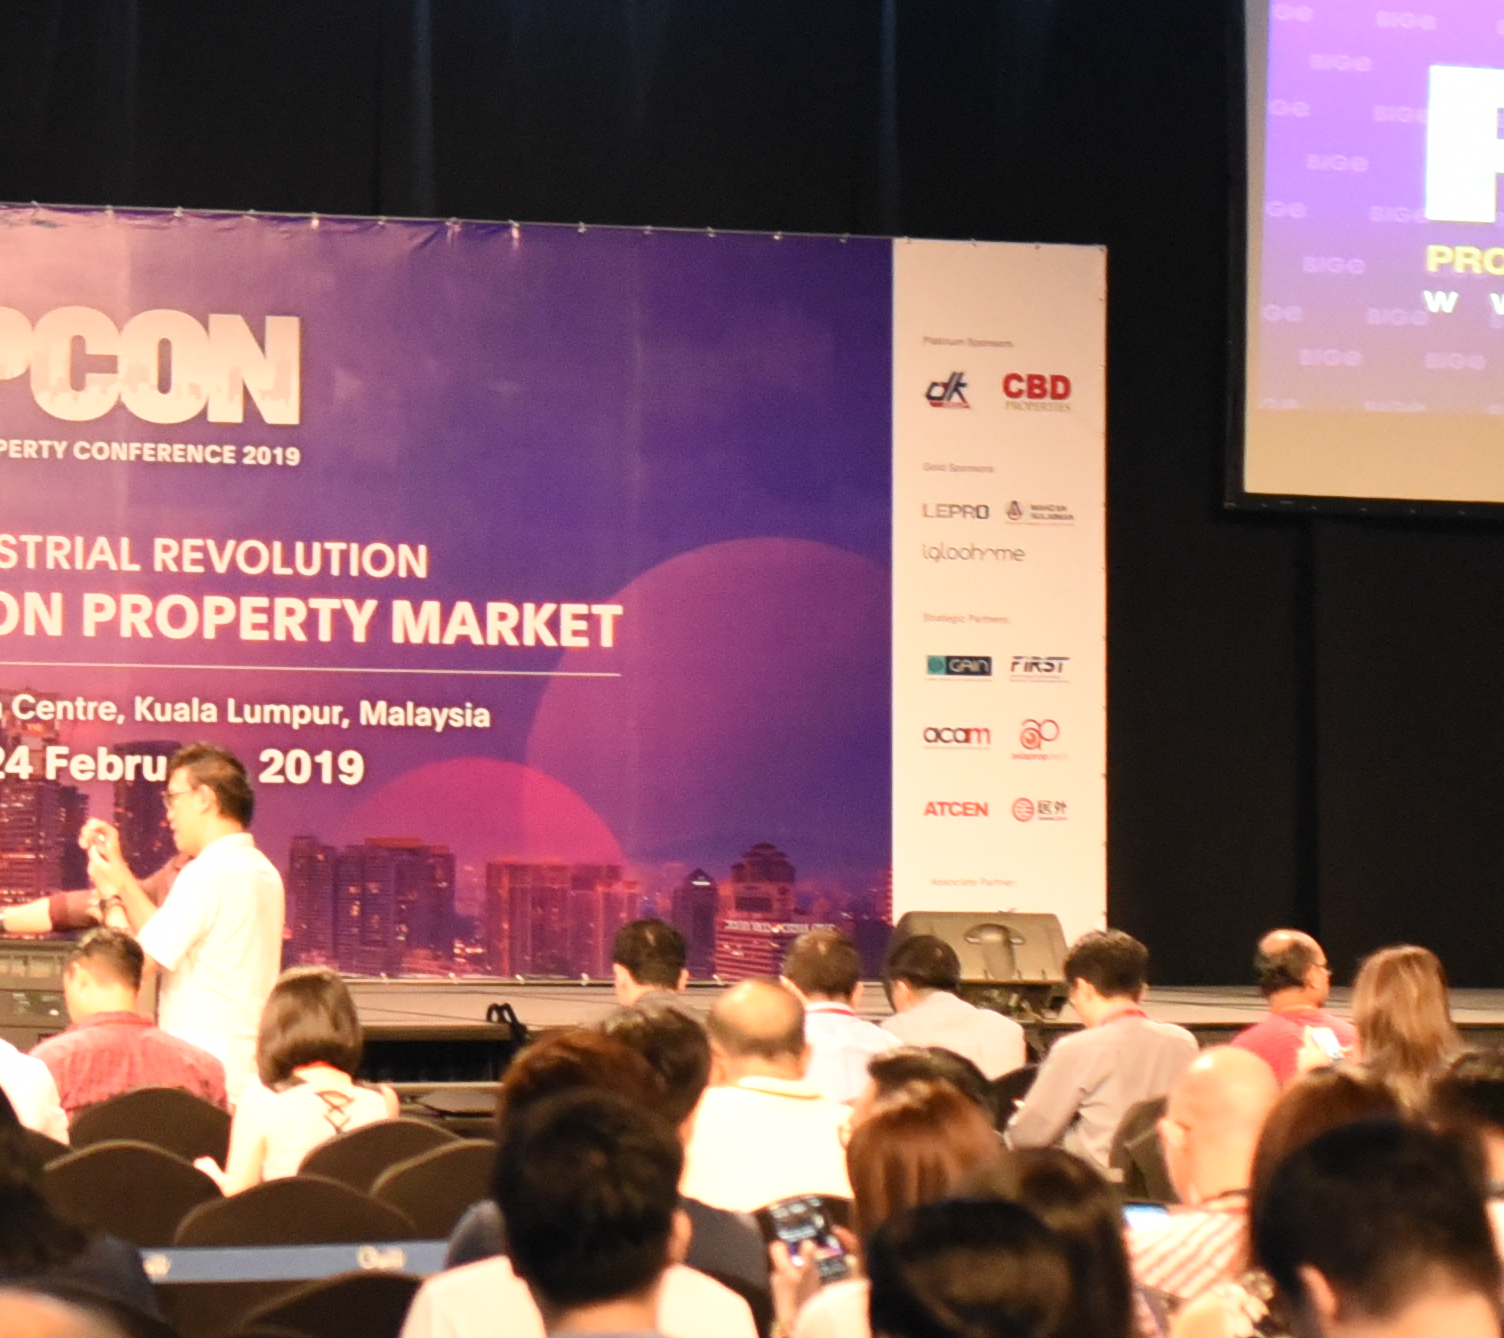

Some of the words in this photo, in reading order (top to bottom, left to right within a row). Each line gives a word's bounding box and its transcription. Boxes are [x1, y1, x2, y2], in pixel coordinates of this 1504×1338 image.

[1003, 373, 1072, 400] CBD
[72, 441, 236, 465] CONFERENCE
[242, 446, 301, 466] 2019
[153, 537, 428, 579] REVOLUTION
[83, 593, 378, 643] PROPERTY
[392, 599, 624, 648] MARKET
[11, 694, 126, 726] Centre,
[134, 697, 219, 724] Kuala
[227, 698, 351, 730] Lumpur,
[359, 700, 491, 733] Malaysia
[258, 748, 364, 785] 2019
[923, 801, 989, 817] ATCEN
